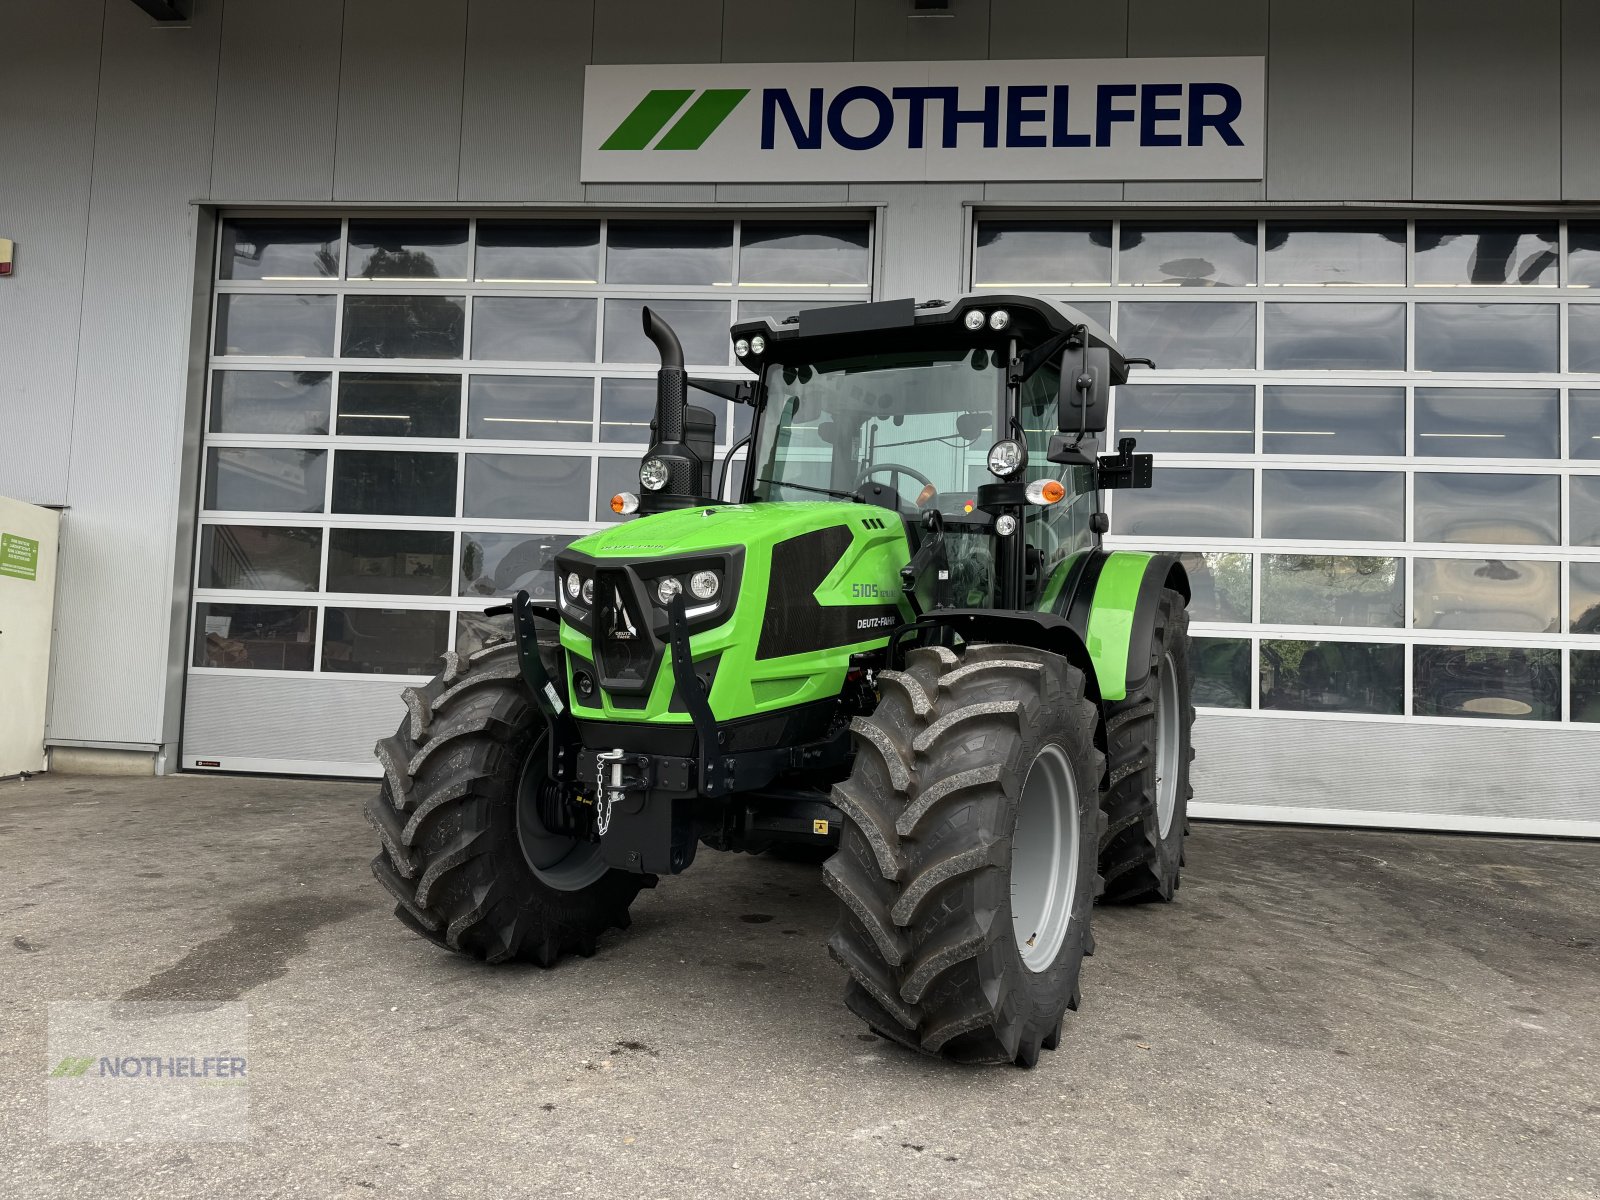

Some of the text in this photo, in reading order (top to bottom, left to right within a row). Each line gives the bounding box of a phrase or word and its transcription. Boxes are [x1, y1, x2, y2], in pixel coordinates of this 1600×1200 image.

[761, 83, 1245, 150] NOTHELFER
[852, 583, 879, 598] 5105
[857, 616, 896, 629] DEUTZ-FAHR
